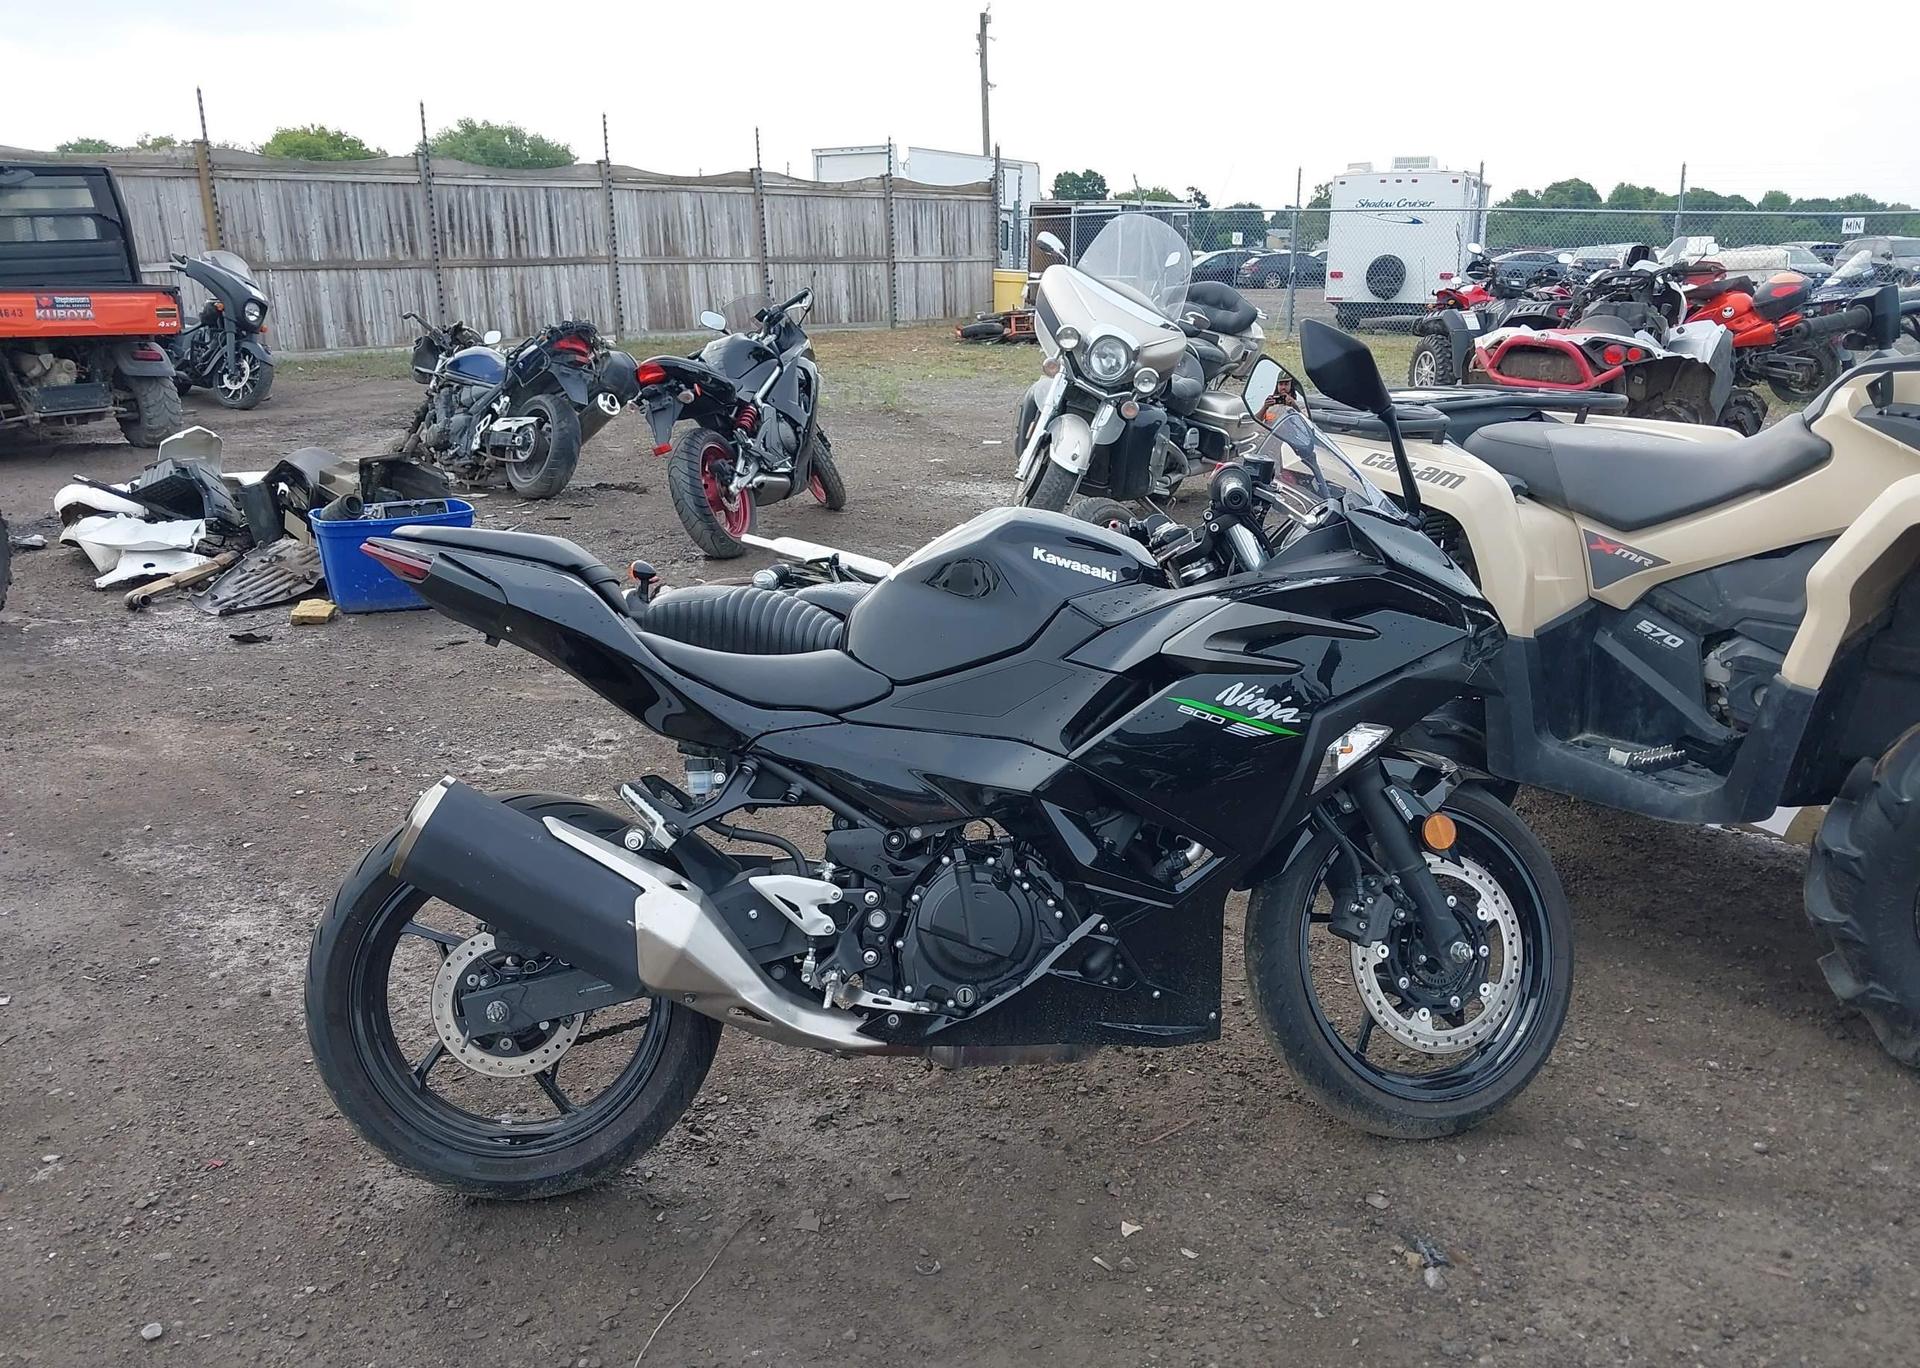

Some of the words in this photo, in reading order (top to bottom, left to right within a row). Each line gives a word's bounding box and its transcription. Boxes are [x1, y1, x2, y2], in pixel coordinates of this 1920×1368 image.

[1355, 198, 1396, 208] Shadow
[1397, 198, 1435, 208] Cruiser
[36, 309, 94, 320] KUBOTA
[1032, 546, 1117, 583] Kawasaki
[1636, 619, 1685, 648] 570
[1177, 704, 1226, 725] 500
[1215, 682, 1301, 723] Ninja
